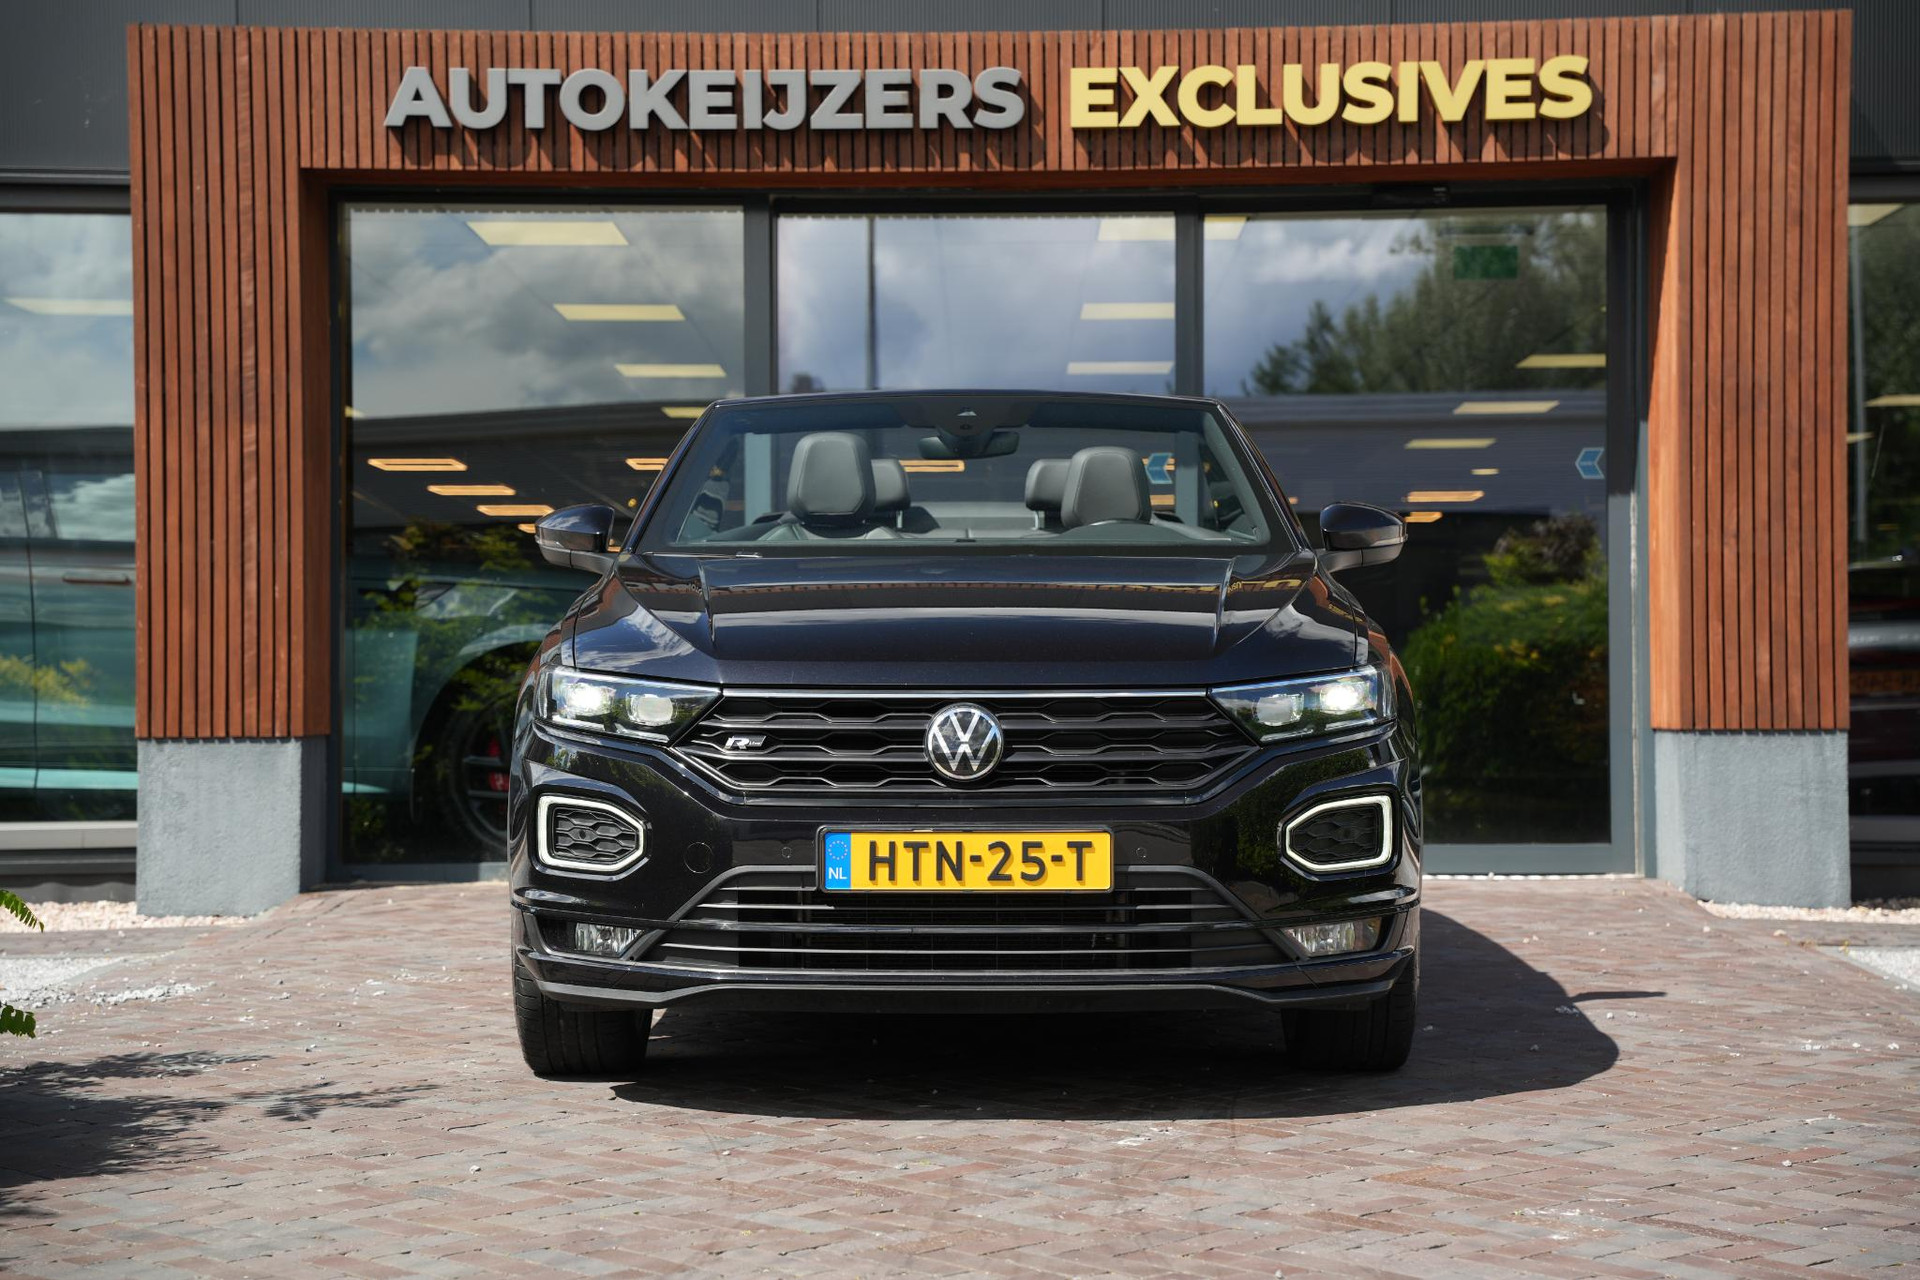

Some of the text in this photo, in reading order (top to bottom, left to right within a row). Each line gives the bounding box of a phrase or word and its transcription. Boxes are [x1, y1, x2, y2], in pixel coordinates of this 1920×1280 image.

[384, 55, 1594, 131] AUTOKEIJZERS EXCLUSIVES
[927, 704, 1003, 781] VW
[828, 866, 847, 880] NL
[868, 840, 1093, 882] HTN-25-T
